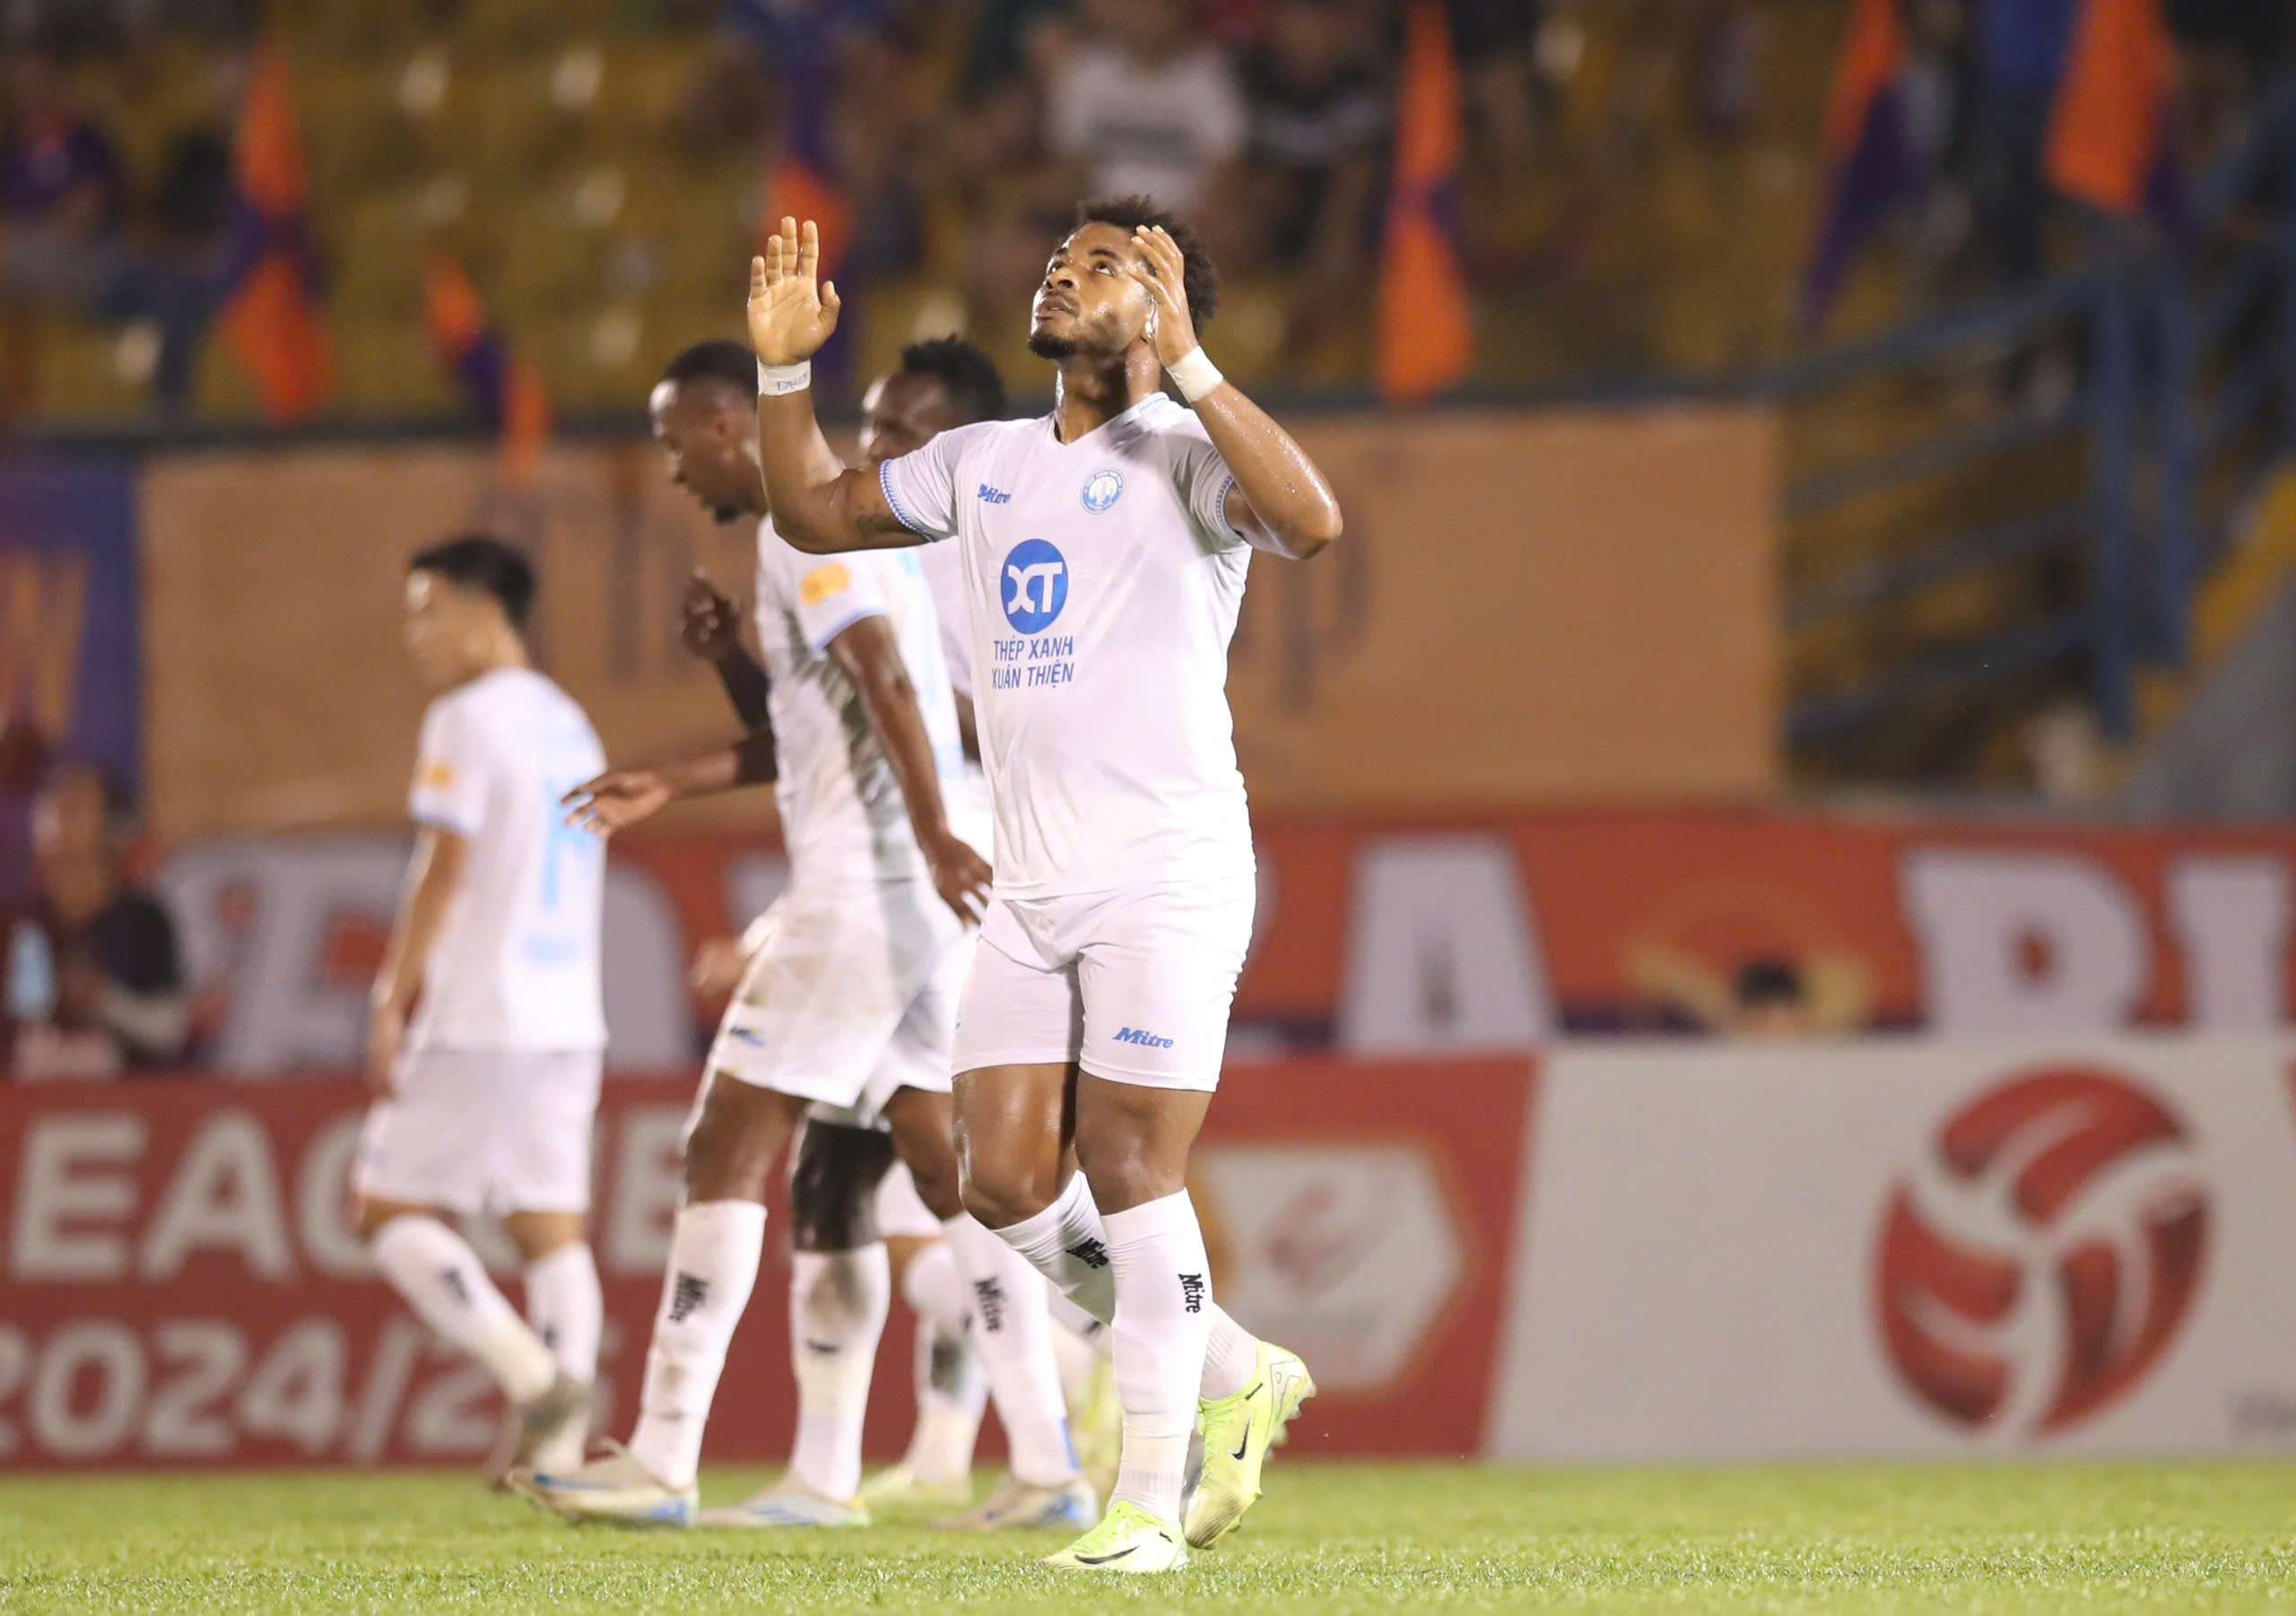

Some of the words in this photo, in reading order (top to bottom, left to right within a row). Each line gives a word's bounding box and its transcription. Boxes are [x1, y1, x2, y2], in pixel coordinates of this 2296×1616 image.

[1007, 561, 1063, 615] XT
[993, 635, 1024, 661] THÉP
[1028, 635, 1074, 660] XANH
[991, 664, 1022, 690] XUÂN
[1027, 659, 1074, 689] THIỆN
[1112, 1026, 1174, 1048] Mitre
[1178, 1273, 1205, 1314] Mitre
